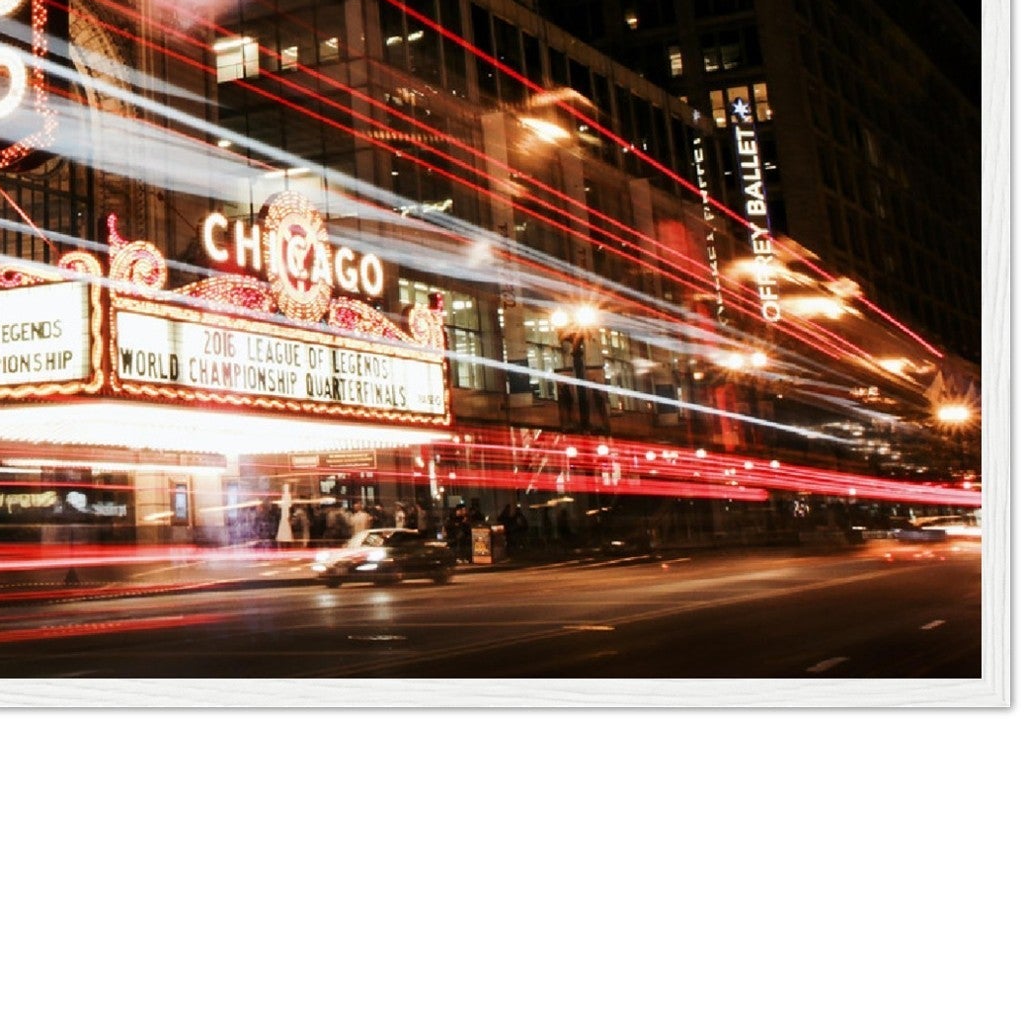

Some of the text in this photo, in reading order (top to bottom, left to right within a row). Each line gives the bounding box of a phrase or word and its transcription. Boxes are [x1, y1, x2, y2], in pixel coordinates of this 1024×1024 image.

[735, 125, 767, 217] BALLET
[203, 212, 384, 296] CHICAGO
[120, 347, 180, 382] WORLD
[188, 356, 298, 395] CHAMPIONSHIP
[305, 372, 407, 408] QUARTERFINALS
[203, 330, 389, 380] 2016 LEAGUE OF LEGENDS
